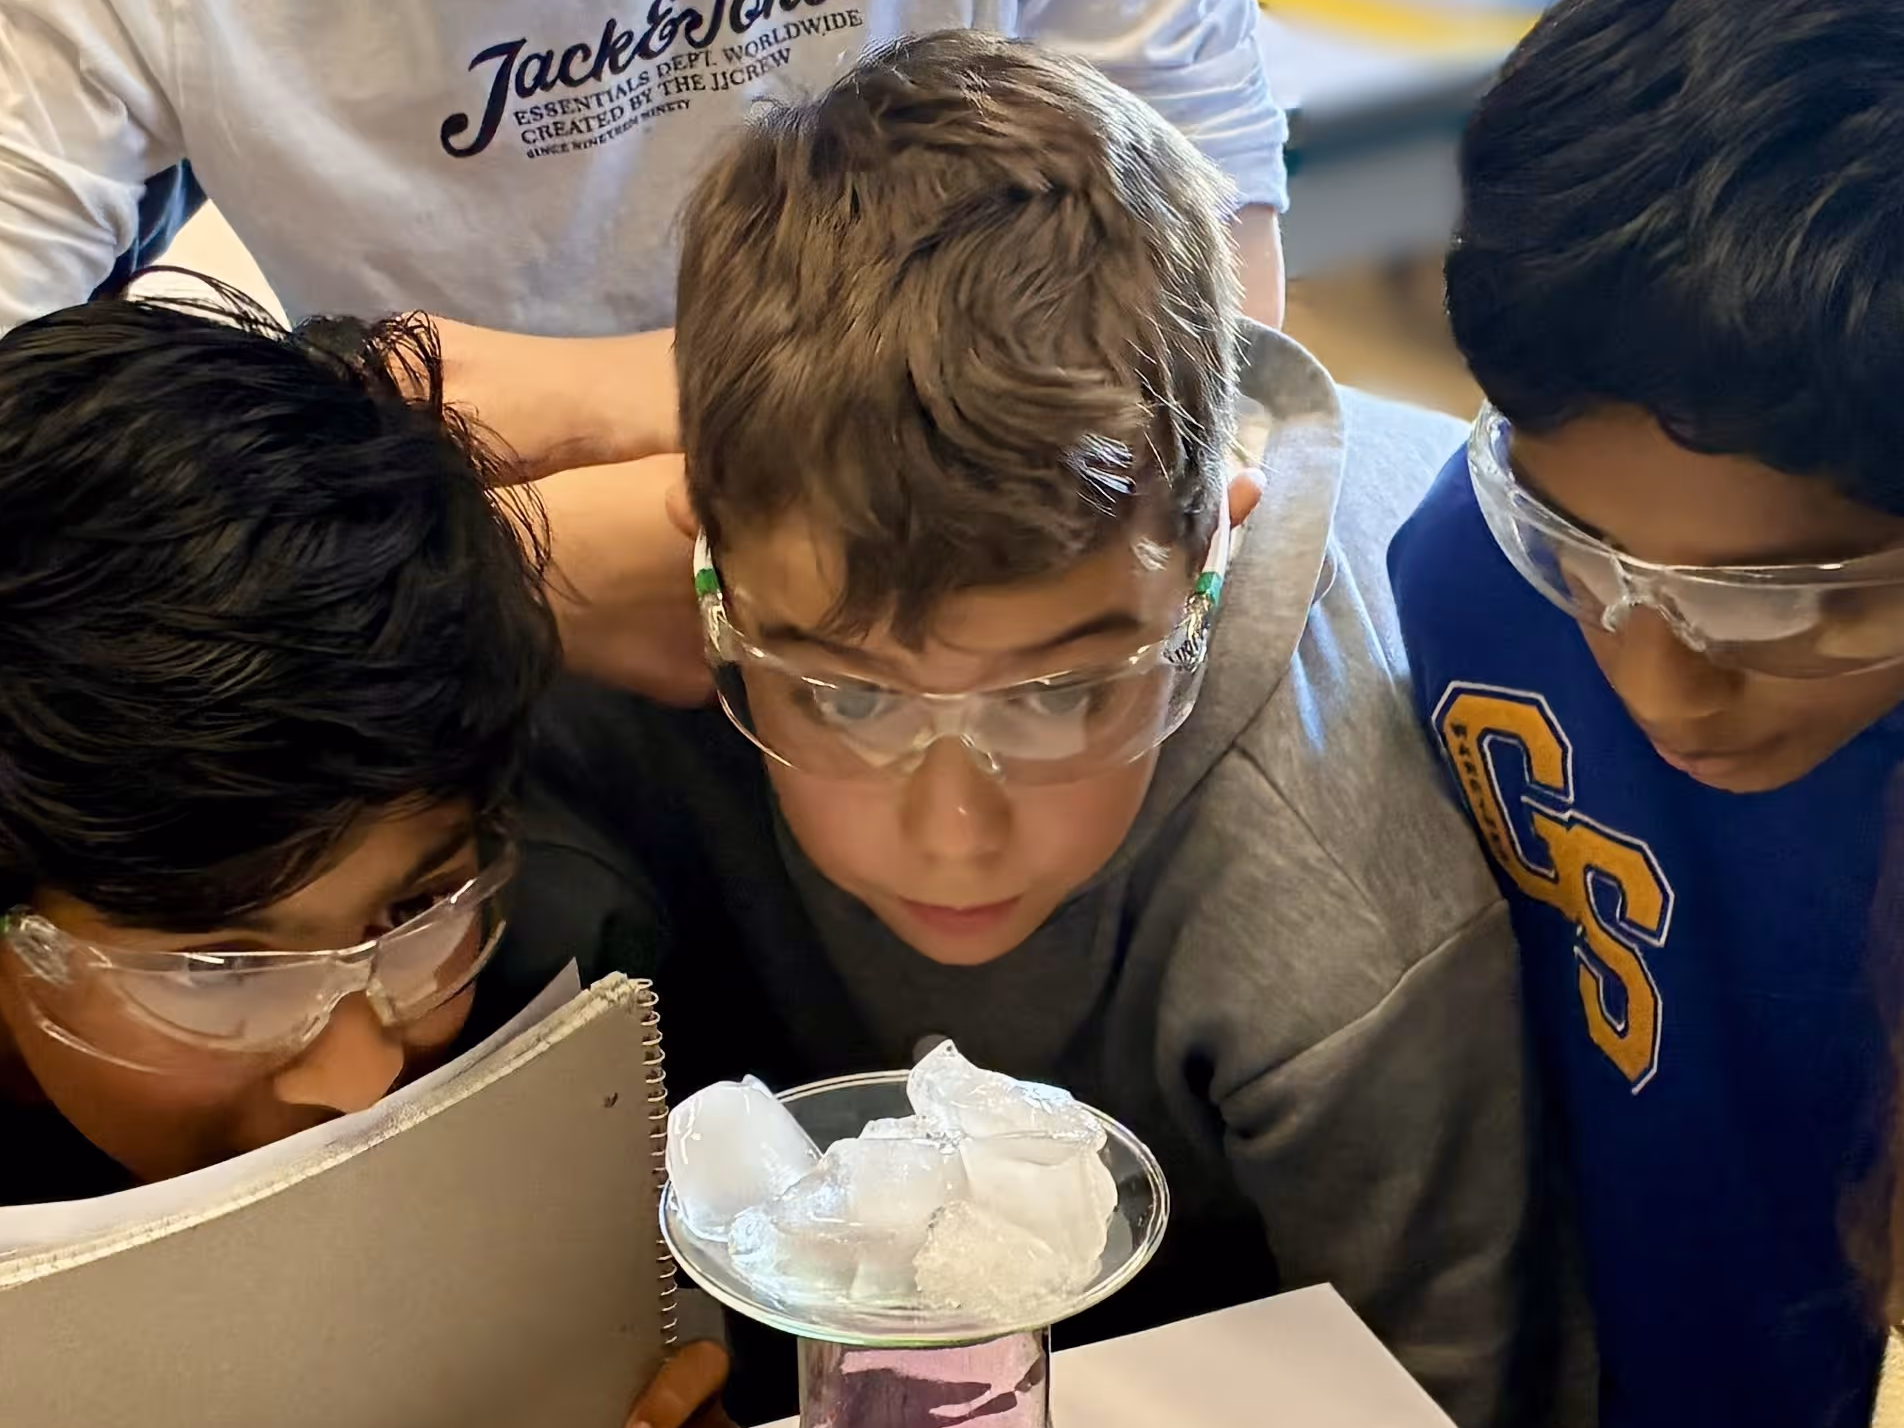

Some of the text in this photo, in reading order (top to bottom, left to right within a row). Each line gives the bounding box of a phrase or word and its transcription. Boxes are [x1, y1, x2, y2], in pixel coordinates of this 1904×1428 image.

[513, 9, 864, 126] ESSENTIALS DEPT. WORLDWIDE
[521, 47, 793, 145] CREATED BY THE JJCREW
